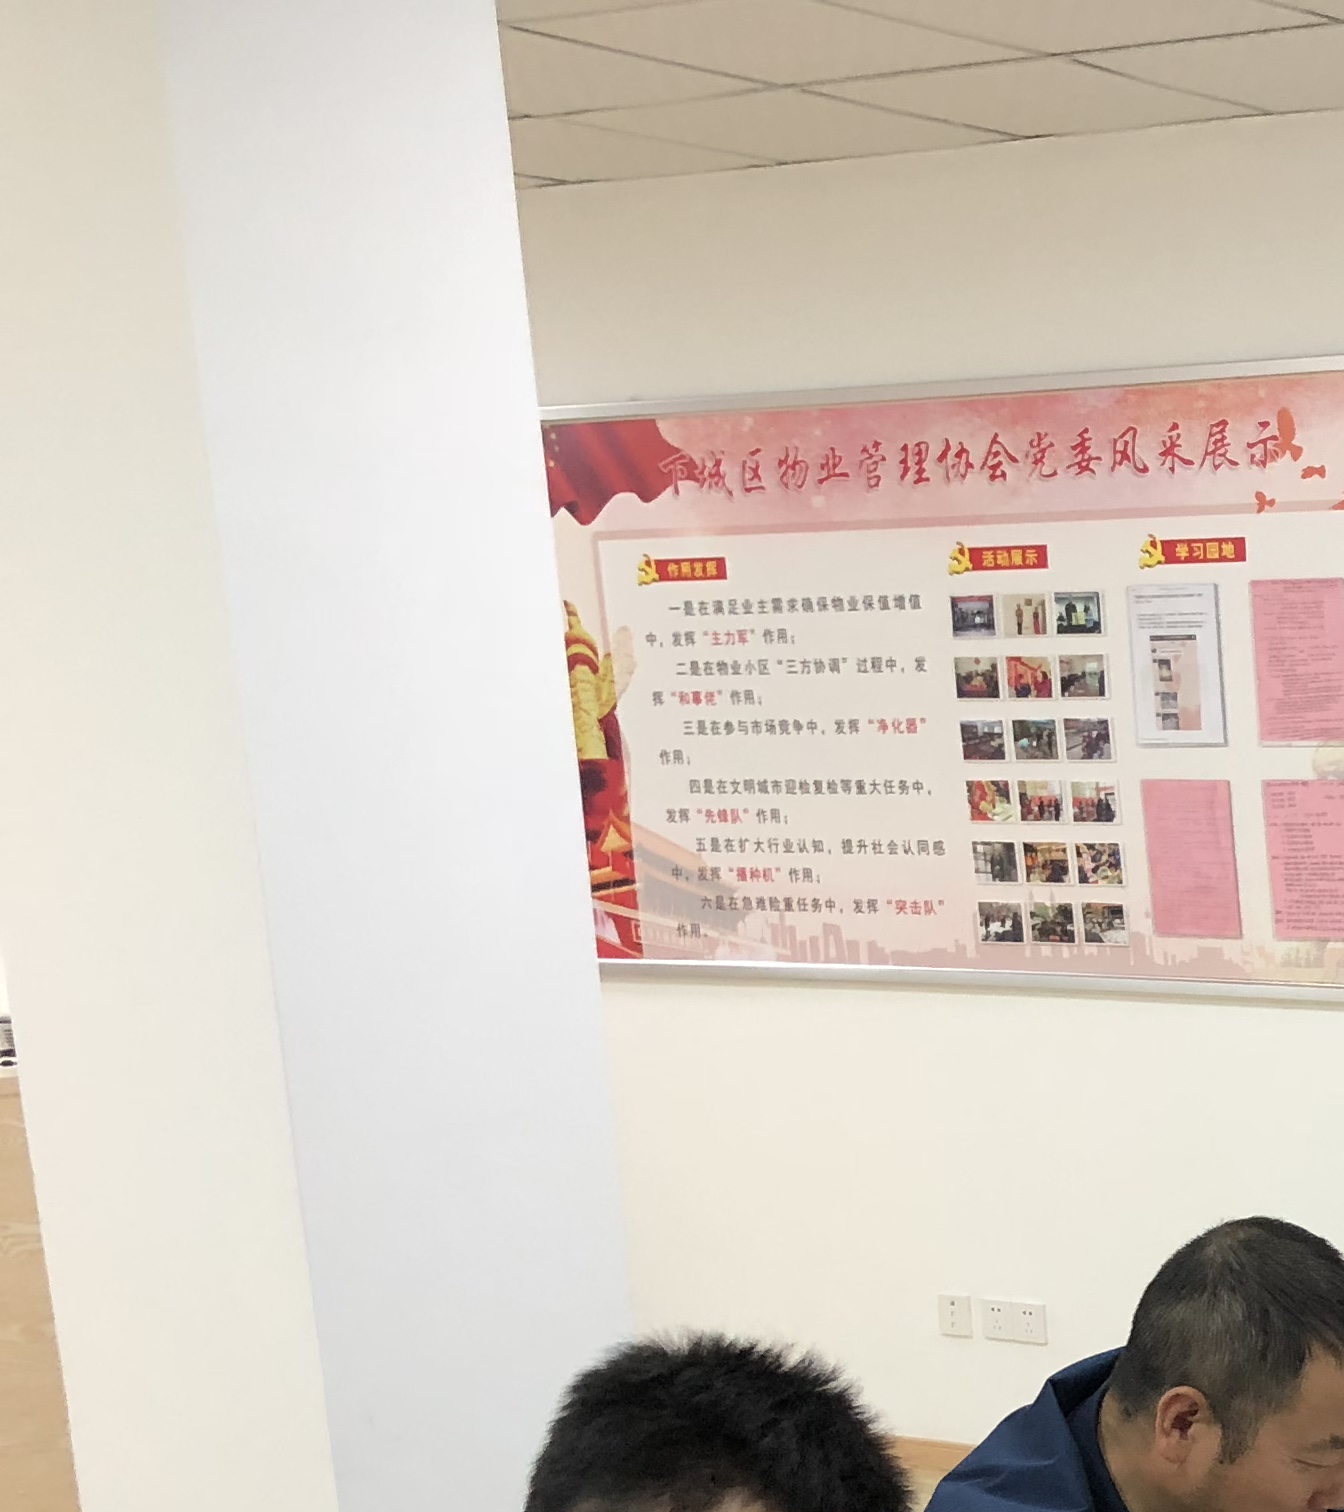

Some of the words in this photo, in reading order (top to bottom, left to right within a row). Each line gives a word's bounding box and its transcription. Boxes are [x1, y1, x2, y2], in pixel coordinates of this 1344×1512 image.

[658, 418, 1282, 499] 下城区物业管理协会党委风采展示
[981, 549, 1039, 568] 活动展示
[1175, 541, 1236, 560] 学习园地
[667, 560, 719, 579] 作用发挥
[669, 594, 922, 616] 一是在满足业主需求确保物业保值增值
